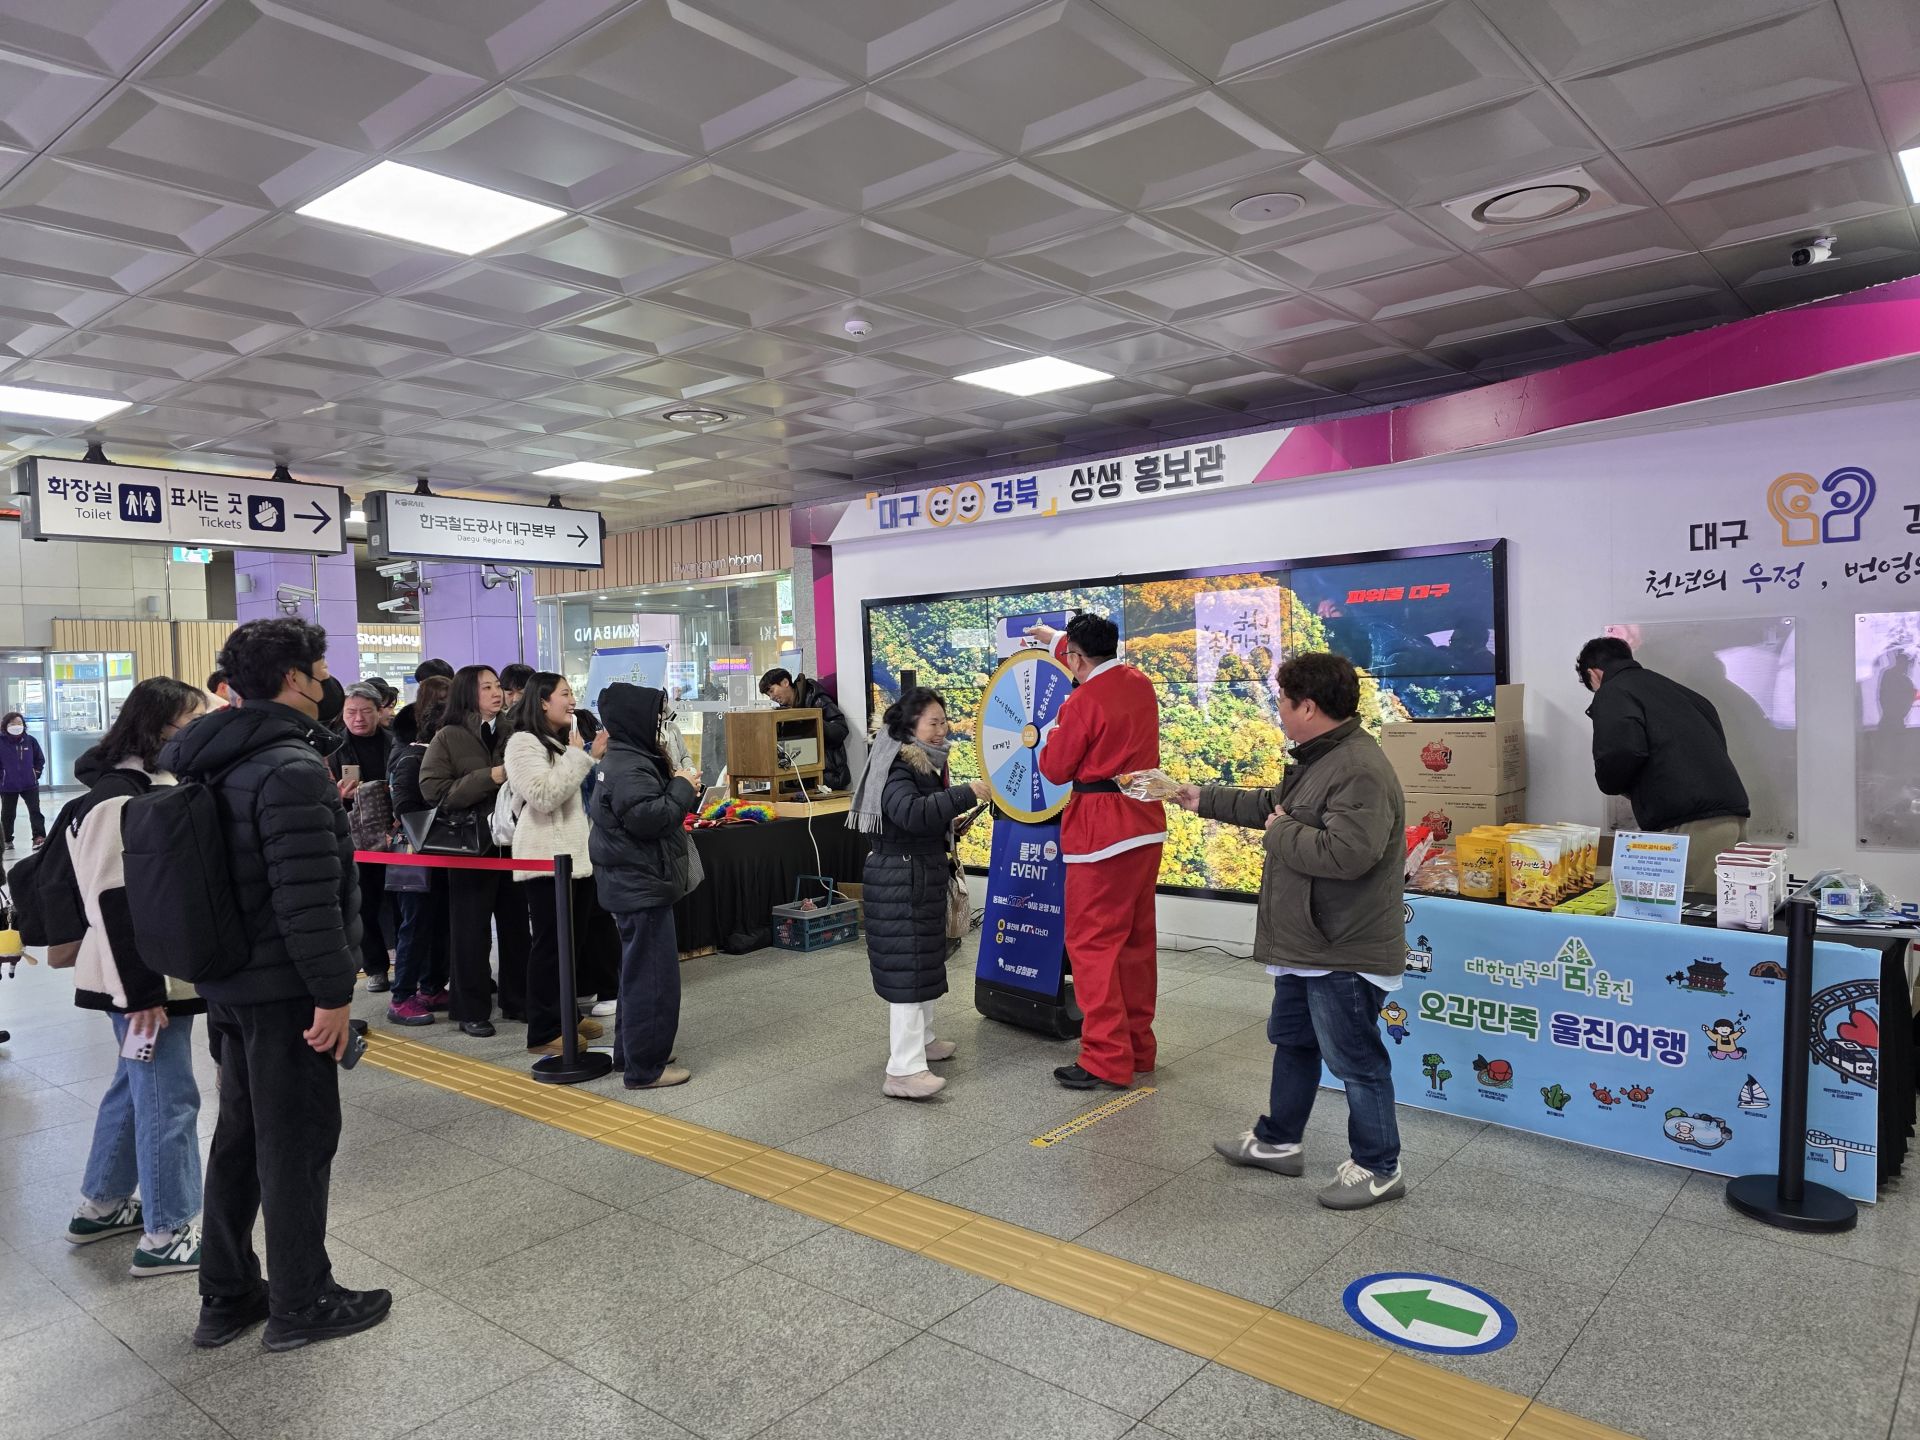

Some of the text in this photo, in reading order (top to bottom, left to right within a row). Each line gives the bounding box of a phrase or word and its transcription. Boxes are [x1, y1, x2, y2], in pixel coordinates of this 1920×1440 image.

[47, 476, 243, 515] 화장실 표사는 곳
[878, 444, 1226, 530] 대구 경북 상생 홍보관
[75, 507, 243, 531] Toilet Tickets
[419, 513, 556, 539] 한국철도공사 대구본부
[457, 534, 525, 546] Daegu Regional HQ
[1689, 519, 1749, 552] 대구
[728, 553, 762, 567] bbang
[1645, 569, 1727, 599] 천년의
[1742, 562, 1806, 594] 우정
[356, 632, 421, 647] StoryWay
[1020, 842, 1041, 862] 룰렛
[1010, 861, 1048, 881] EVENT
[1465, 959, 1556, 987] 대한민국의
[1595, 973, 1633, 1004] 울진
[1420, 991, 1687, 1066] 오감만족 울진여행
